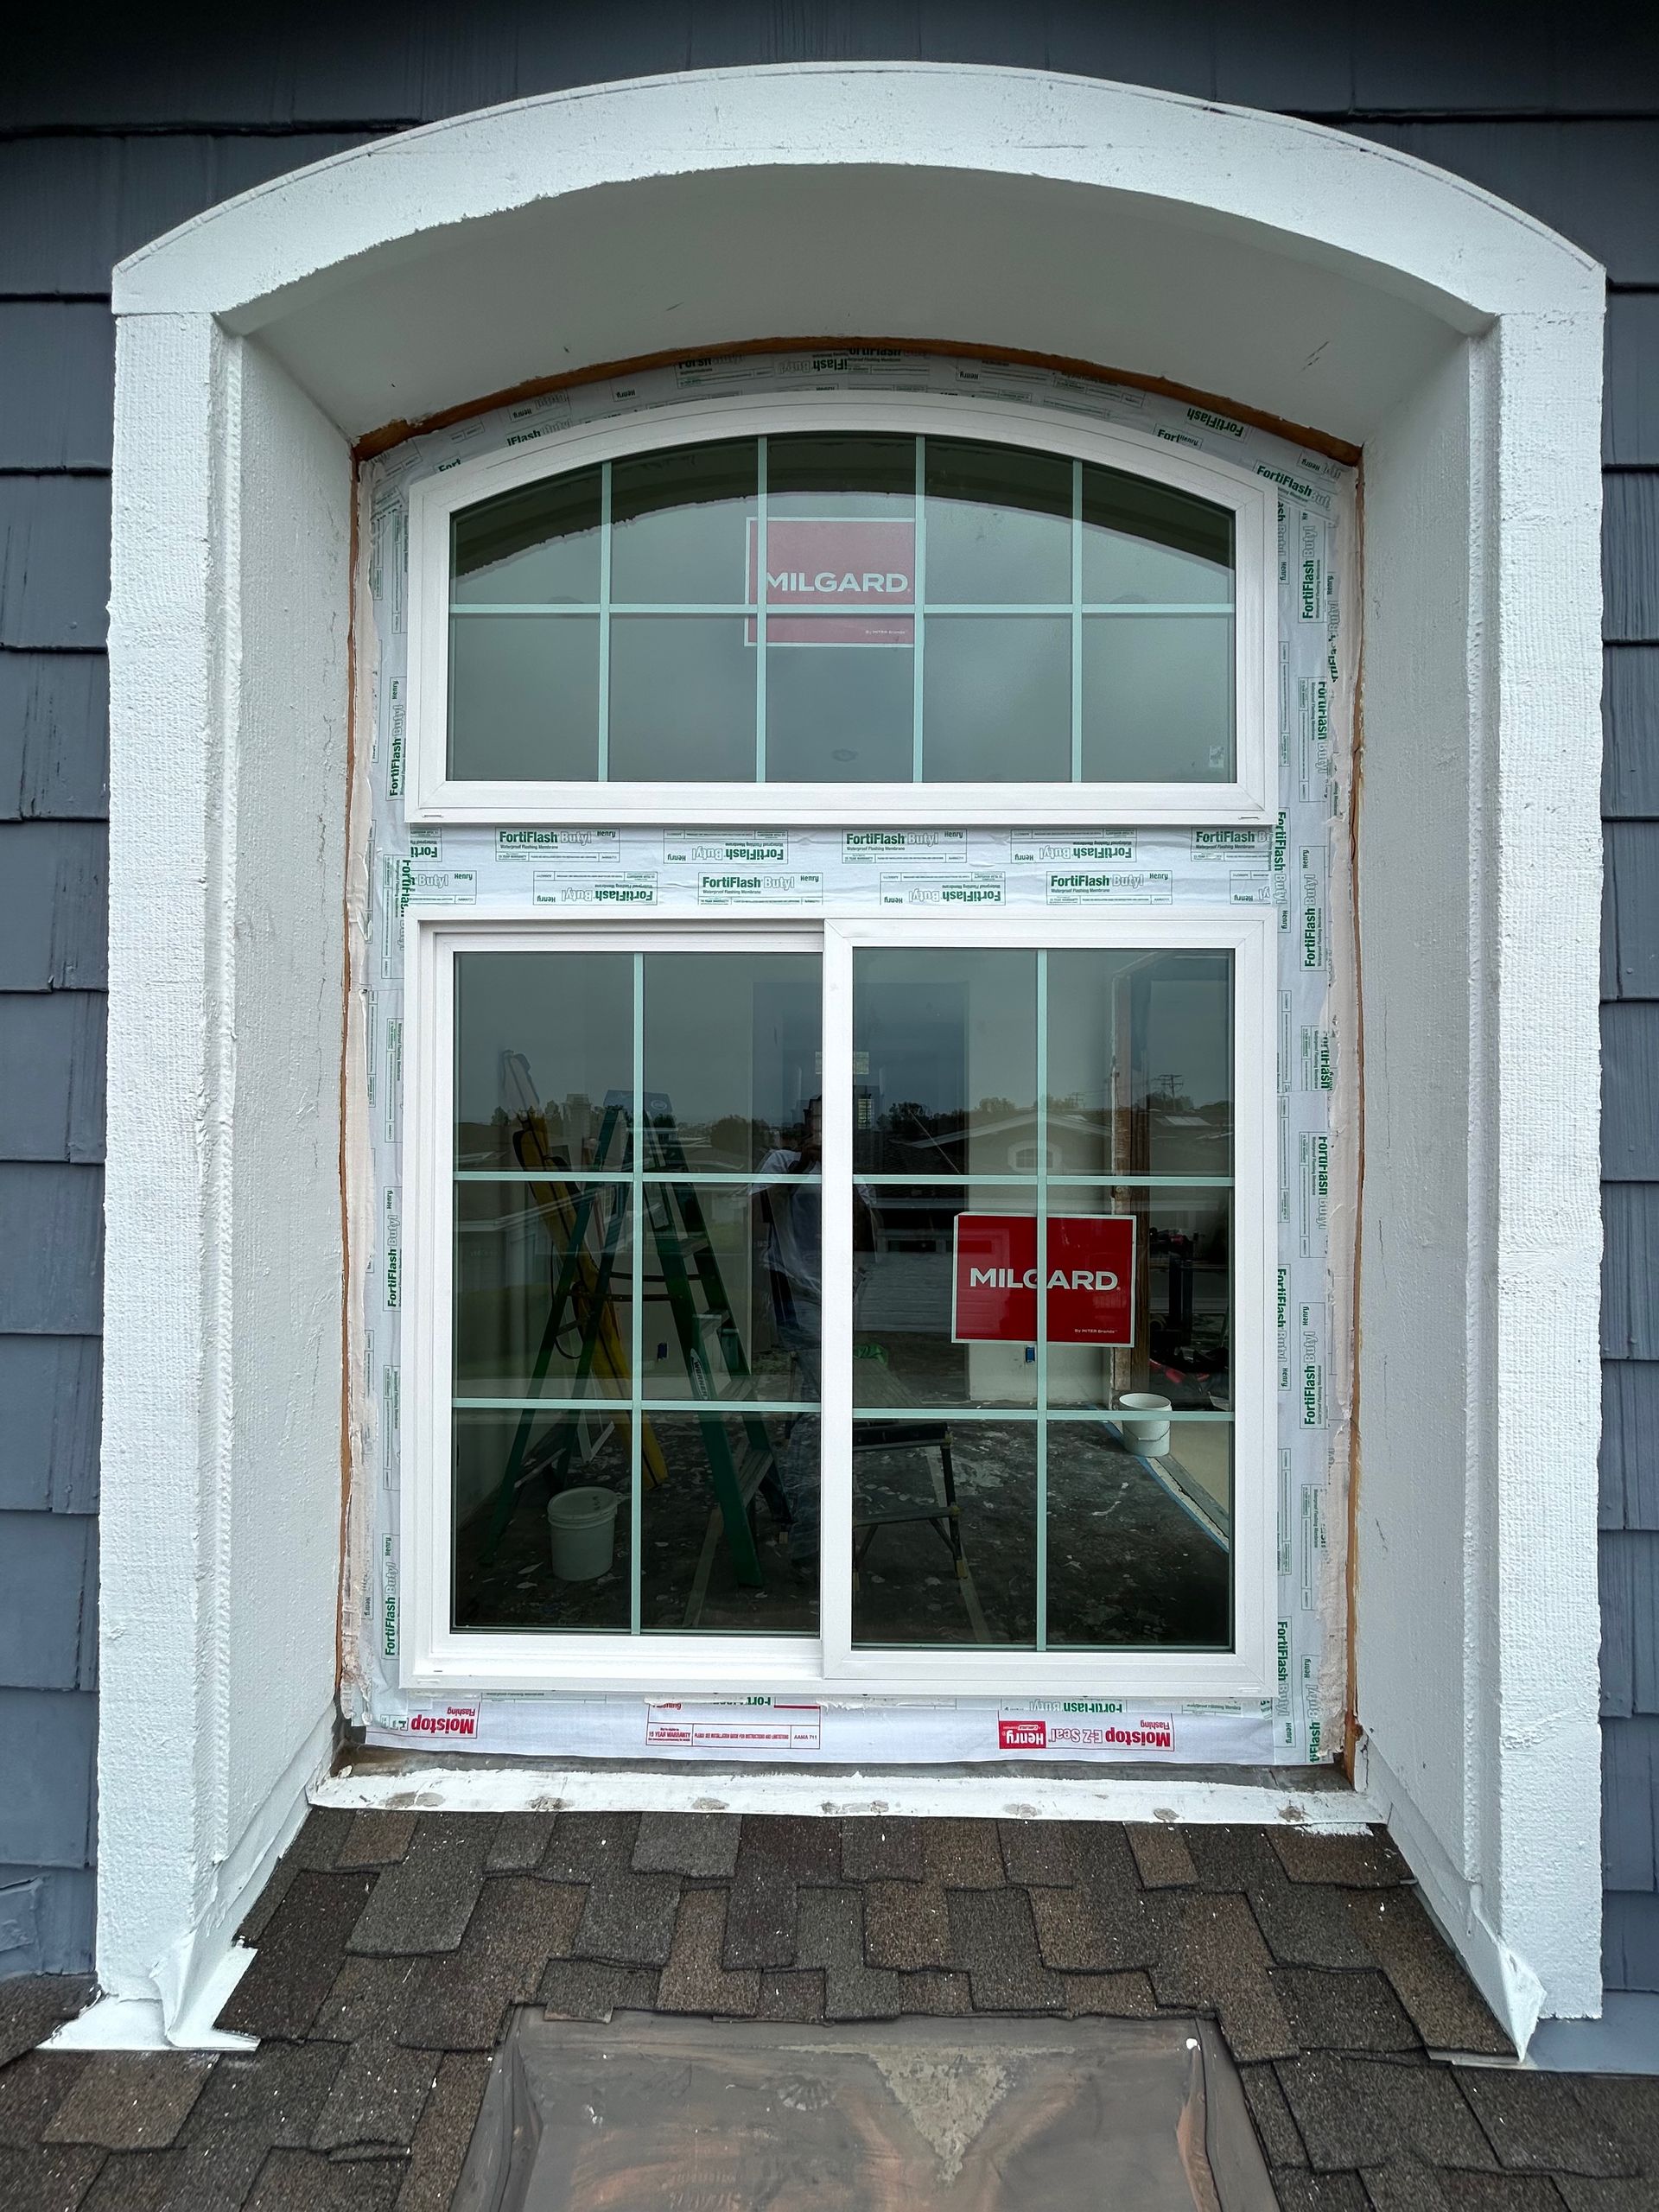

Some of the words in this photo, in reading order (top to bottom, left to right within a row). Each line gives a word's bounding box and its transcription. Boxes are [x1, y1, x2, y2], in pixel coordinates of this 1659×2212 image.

[1187, 408, 1244, 437] FortiFlash
[1256, 465, 1313, 497] FortiFlash
[1303, 525, 1318, 557] Butyl
[766, 572, 908, 593] MILGARD
[1303, 560, 1314, 619] FortiFlash
[393, 704, 405, 735] Butyl
[390, 738, 402, 796] FortiFlash
[499, 831, 558, 843] FortiFlash
[561, 831, 592, 846] Butyl
[596, 830, 616, 838] Henry
[846, 833, 905, 845] FortiFlash
[907, 832, 938, 847] Butyl
[944, 830, 963, 839] Henry
[1195, 830, 1255, 842] FortiFlash
[1274, 811, 1287, 871] FortiFlash
[692, 846, 723, 860] Butyl
[725, 849, 784, 860] FortiFlash
[1014, 853, 1034, 861] Henry
[1039, 845, 1071, 860] Butyl
[1073, 848, 1132, 859] FortiFlash
[417, 874, 448, 887] Butyl
[702, 876, 761, 888] FortiFlash
[763, 876, 795, 891] Butyl
[800, 874, 819, 883] Henry
[1051, 875, 1109, 887] FortiFlash
[1112, 874, 1144, 888] Butyl
[1274, 873, 1287, 904] Butyl
[561, 887, 593, 901] Butyl
[595, 890, 653, 901] FortiFlash
[909, 888, 940, 902] Butyl
[942, 891, 1001, 902] FortiFlash
[1304, 874, 1318, 906] Butyl
[1304, 907, 1316, 967] FortiFlash
[387, 1215, 400, 1247] Butyl
[387, 1248, 397, 1307] FortiFlash
[1304, 1331, 1318, 1363] Butyl
[1304, 1365, 1315, 1425] FortiFlash
[385, 1562, 398, 1595] Butyl
[385, 1597, 396, 1656] FortiFlash
[1278, 1621, 1288, 1681] FortiFlash
[447, 1707, 475, 1716] Flashing
[410, 1714, 474, 1734] Moistop
[1140, 1719, 1170, 1729] Flashing
[1006, 1730, 1044, 1745] Henry
[1049, 1728, 1080, 1743] Seal
[1083, 1729, 1103, 1744] E-Z
[1105, 1727, 1171, 1747] Moistop
